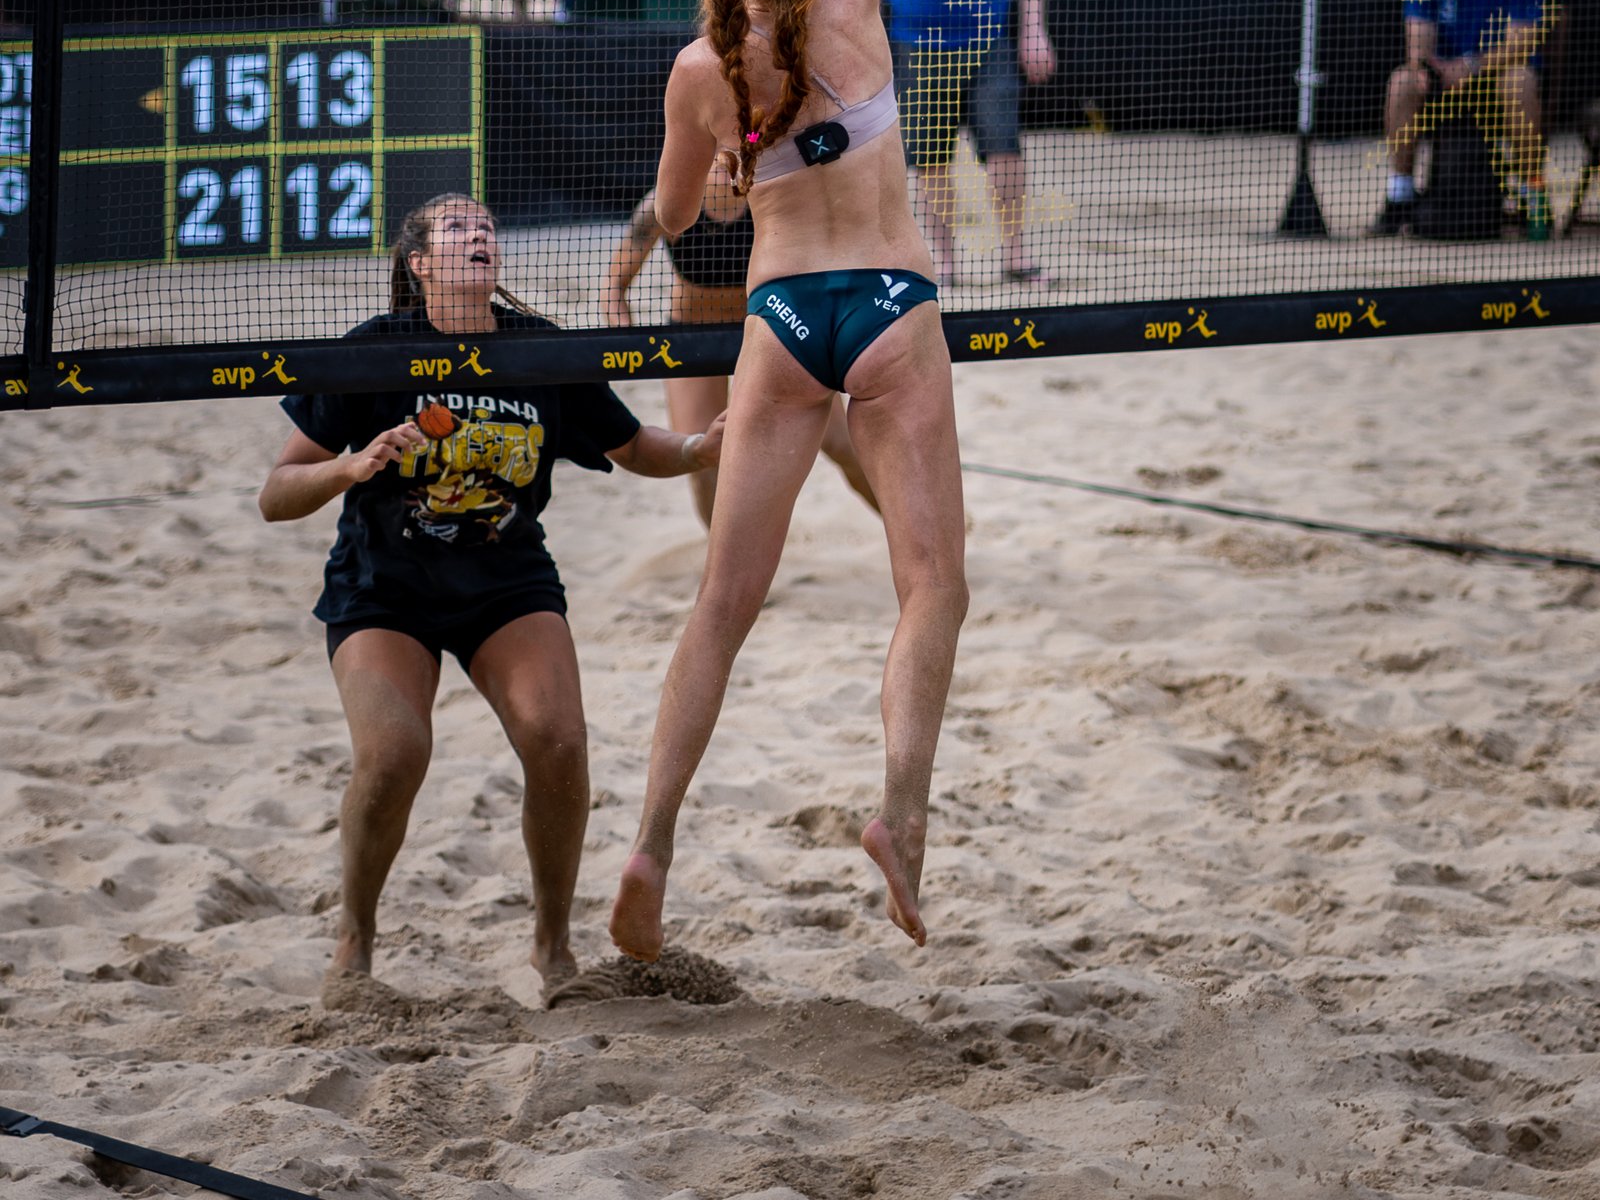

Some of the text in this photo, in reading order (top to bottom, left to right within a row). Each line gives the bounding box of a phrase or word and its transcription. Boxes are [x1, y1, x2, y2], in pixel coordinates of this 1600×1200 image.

[181, 50, 375, 133] 15 13
[178, 161, 374, 246] 21 12
[5, 302, 1517, 397] av avp avp avp avp avp avp avp
[766, 294, 810, 341] CHENG
